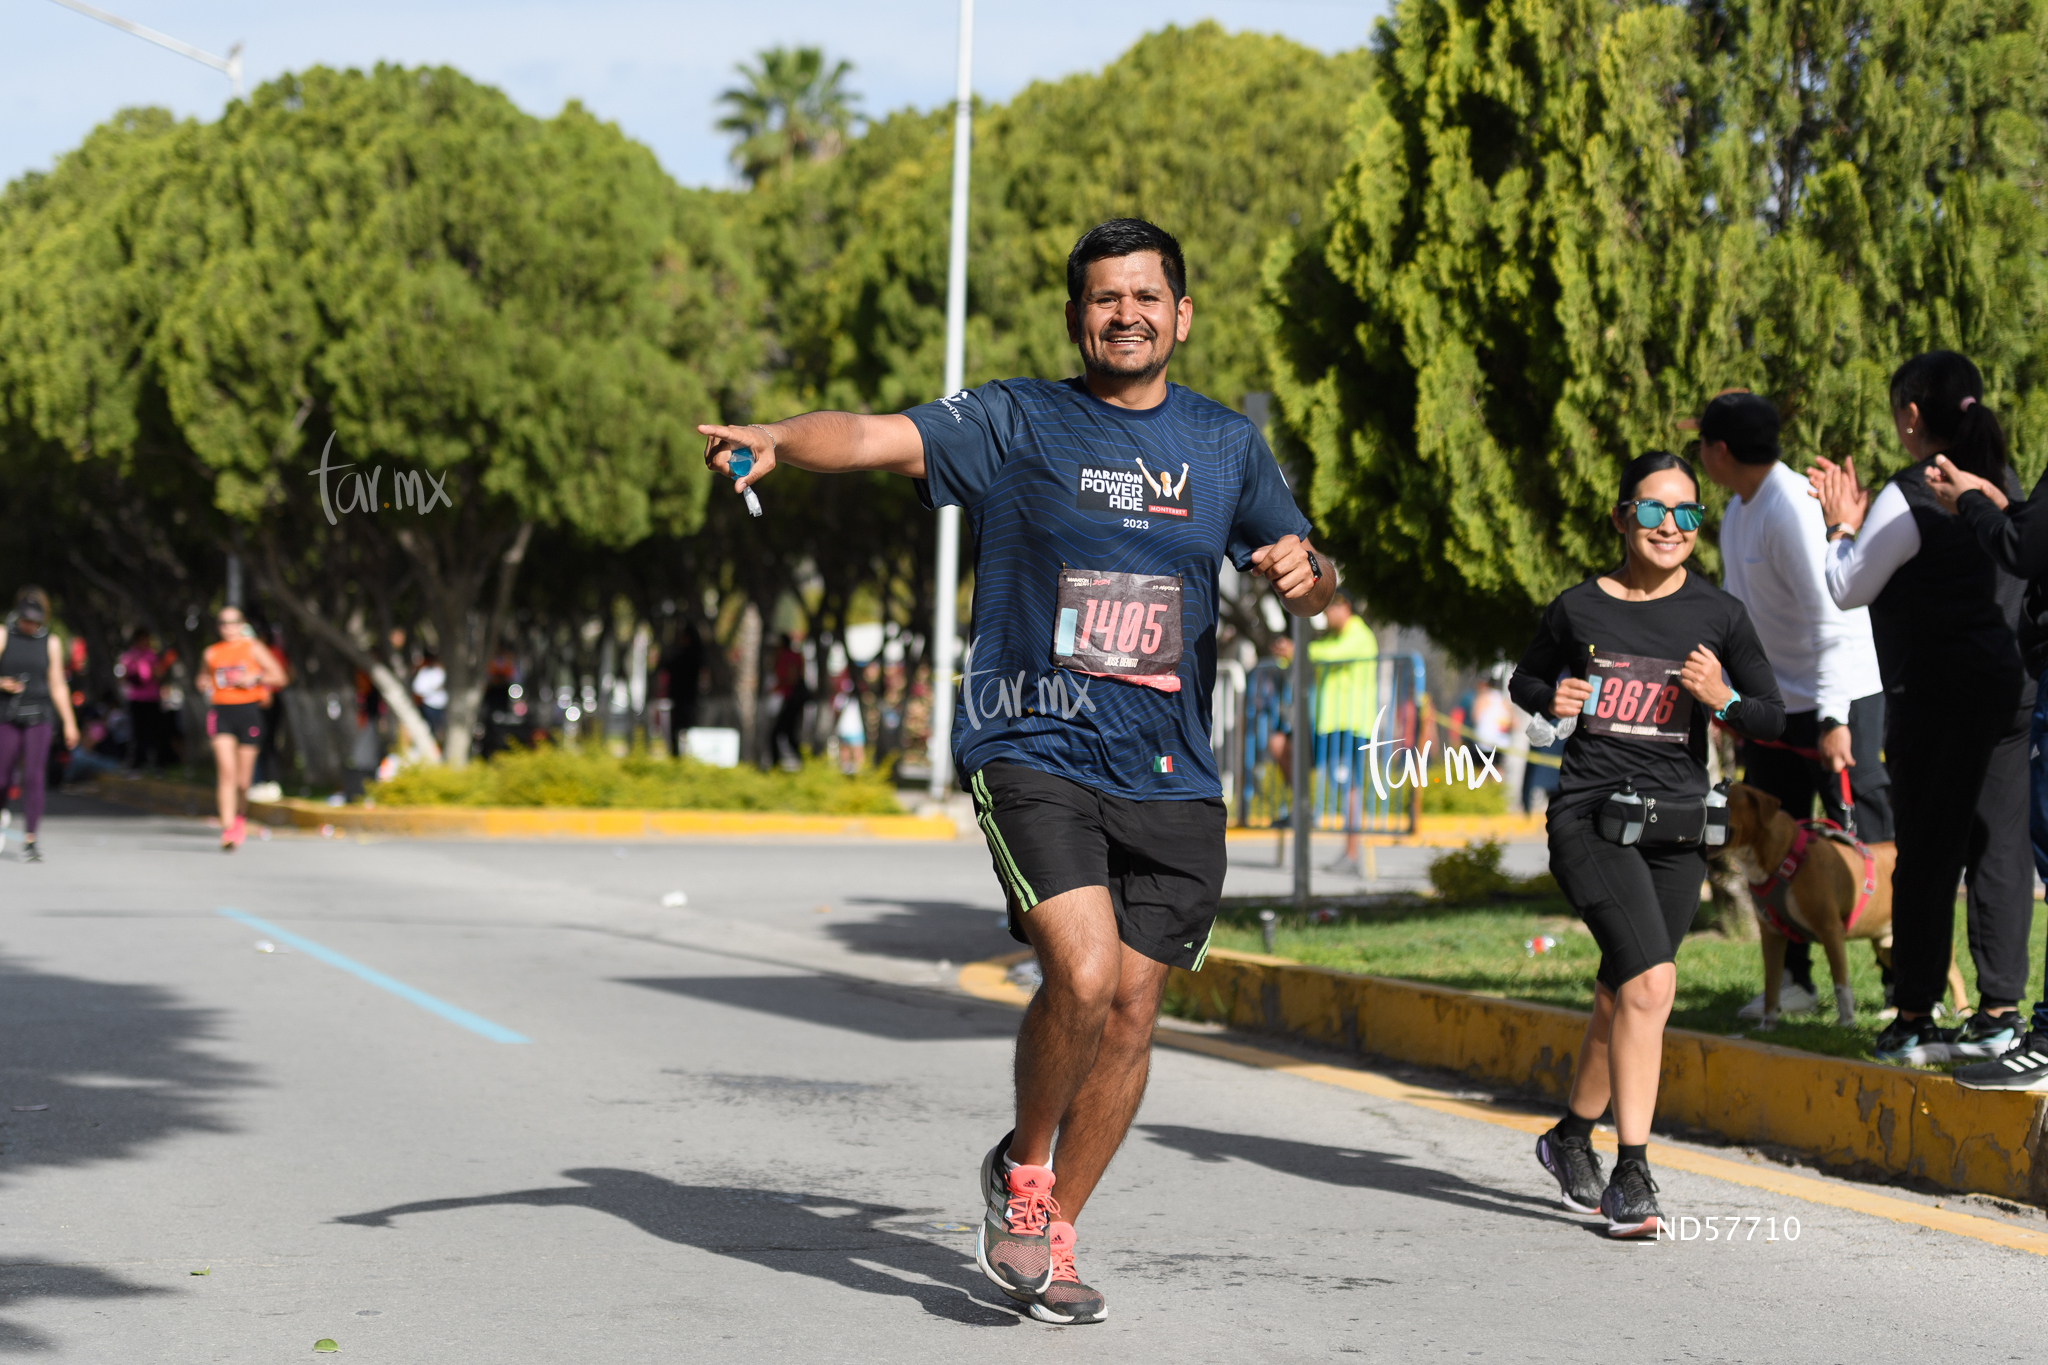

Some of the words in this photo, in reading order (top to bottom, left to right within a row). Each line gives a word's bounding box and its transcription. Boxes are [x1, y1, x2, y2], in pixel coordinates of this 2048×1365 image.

[1081, 468, 1143, 485] MARATÓN
[1080, 478, 1143, 498] POWER
[1108, 494, 1144, 512] ADE
[1150, 506, 1186, 516] MONTERREY
[1123, 518, 1149, 530] 2023
[1078, 599, 1168, 655] 1405
[1596, 677, 1680, 725] 3676
